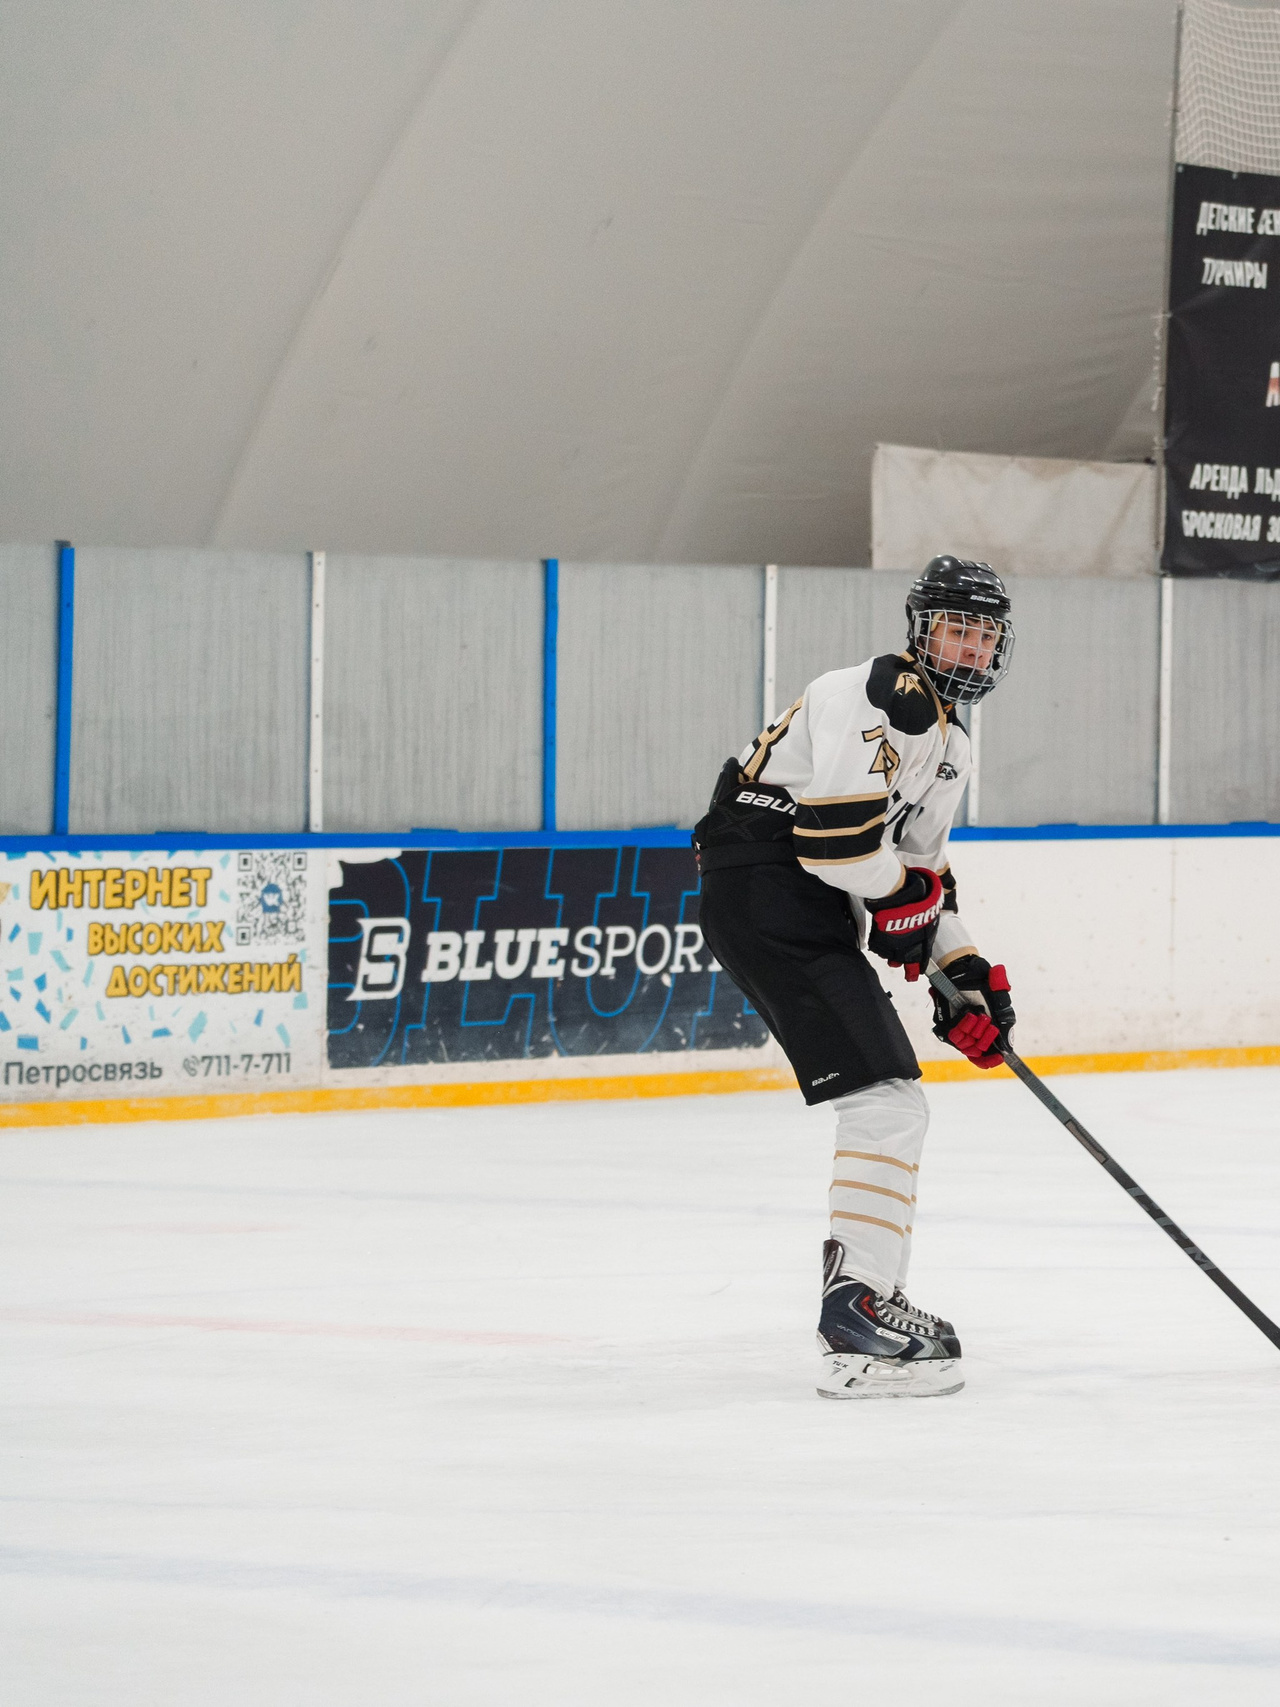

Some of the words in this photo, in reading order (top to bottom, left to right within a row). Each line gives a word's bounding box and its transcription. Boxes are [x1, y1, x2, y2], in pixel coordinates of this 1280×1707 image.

[1196, 201, 1255, 236] ДЕТСКИЕ
[1201, 257, 1268, 289] ТУРНИРЫ
[1189, 463, 1249, 500] АРЕНДА
[1181, 510, 1262, 542] БРОСКОВАЯ
[735, 790, 797, 817] BAU
[29, 867, 213, 910] ИНТЕРНЕТ
[87, 921, 226, 956] ВЫСОКИХ
[105, 953, 303, 998] ДОСТИЖЕНИЙ
[4, 1061, 164, 1088] Петросвязь
[200, 1053, 292, 1078] 711-7-711
